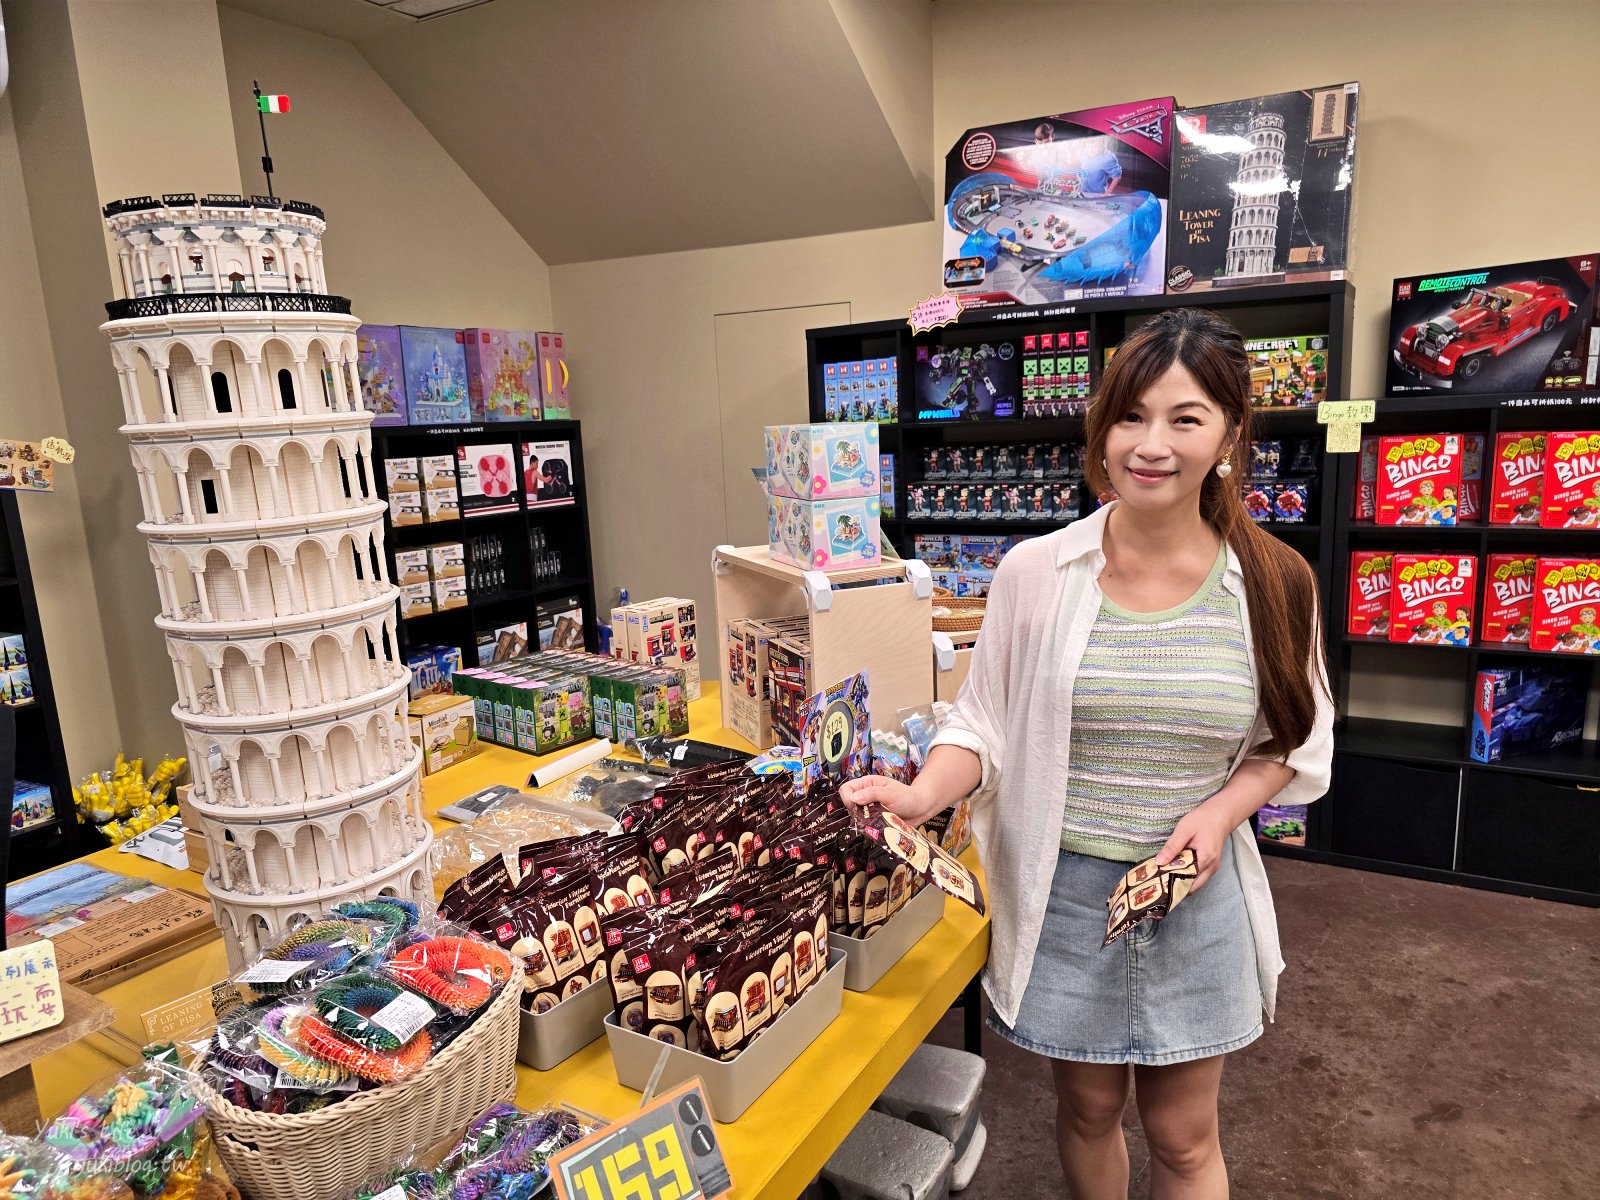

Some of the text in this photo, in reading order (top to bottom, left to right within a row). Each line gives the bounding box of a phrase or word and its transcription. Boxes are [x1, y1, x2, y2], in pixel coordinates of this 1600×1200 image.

[1179, 209, 1221, 221] LEANING
[1184, 220, 1214, 231] TOWER
[1188, 233, 1211, 245] PISA
[1244, 339, 1298, 351] INECRAFT
[1385, 455, 1451, 483] BINGO
[1501, 456, 1544, 481] BIN
[1398, 577, 1465, 603] BINGO
[826, 716, 843, 740] $129
[564, 890, 591, 909] Furniture
[568, 884, 590, 900] Vintage
[745, 927, 793, 961] Victorian Vintage
[768, 934, 793, 956] Furniture
[635, 957, 644, 965] JIE
[636, 963, 650, 972] STAR
[160, 1001, 203, 1026] LEANING
[162, 1012, 202, 1033] OF PISA
